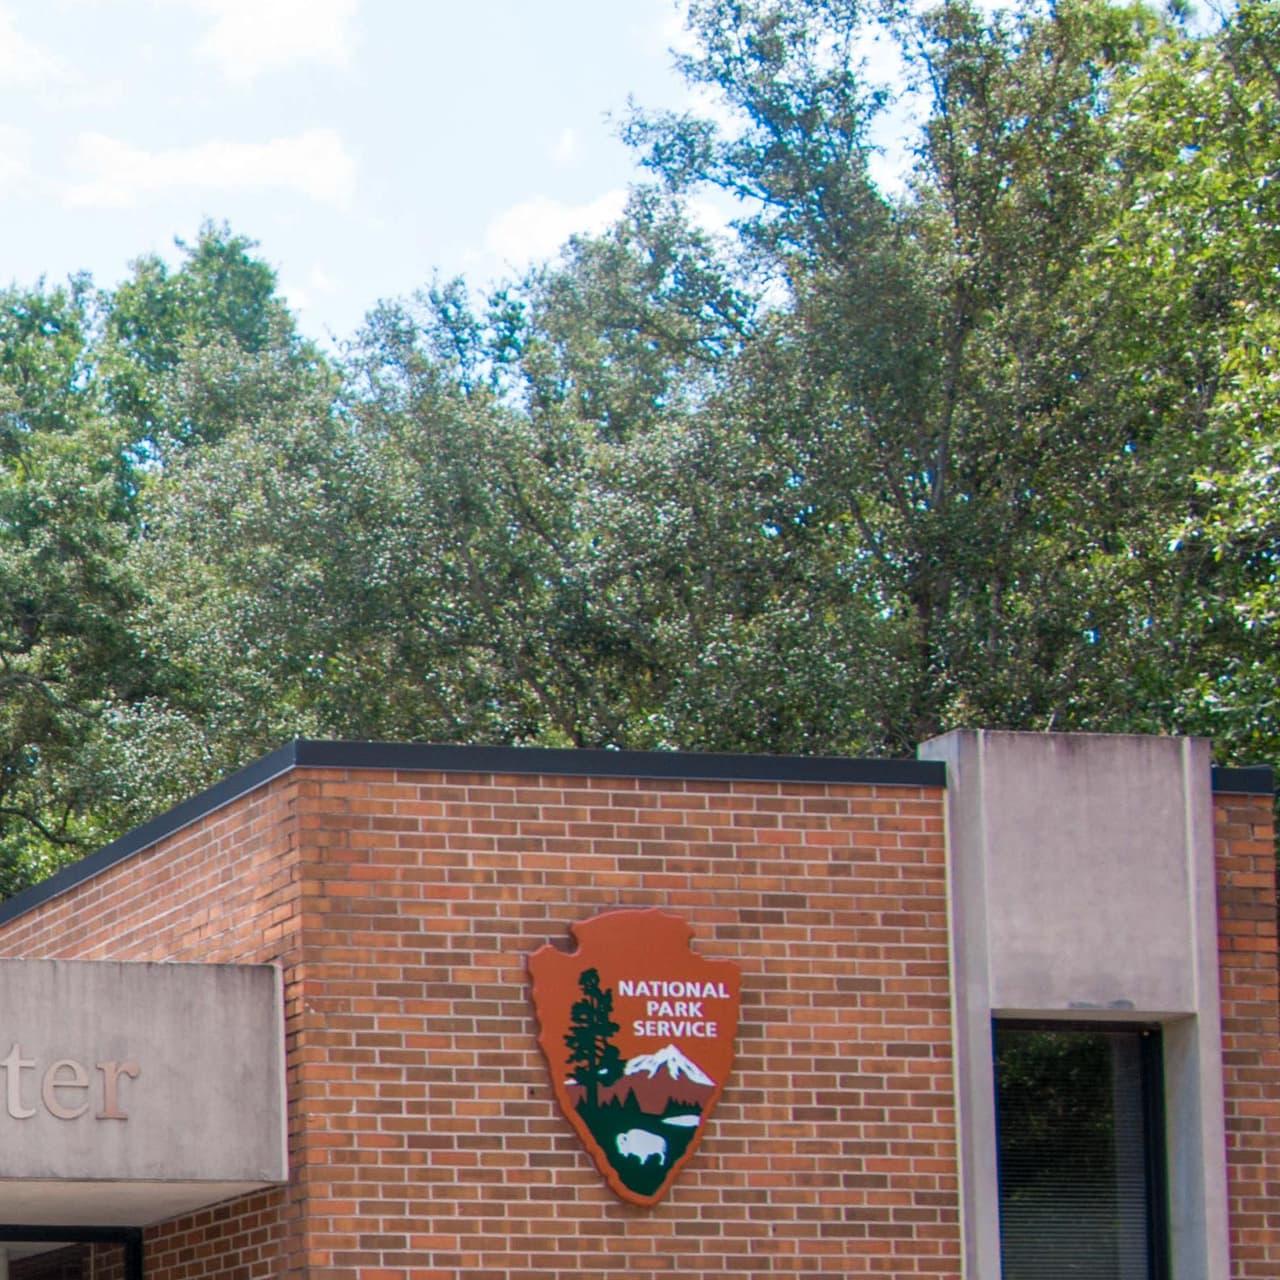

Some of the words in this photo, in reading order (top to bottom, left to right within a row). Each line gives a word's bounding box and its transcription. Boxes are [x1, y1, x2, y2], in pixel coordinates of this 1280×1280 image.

[618, 980, 731, 999] NATIONAL
[646, 1001, 703, 1018] PARK
[633, 1020, 717, 1038] SERVICE
